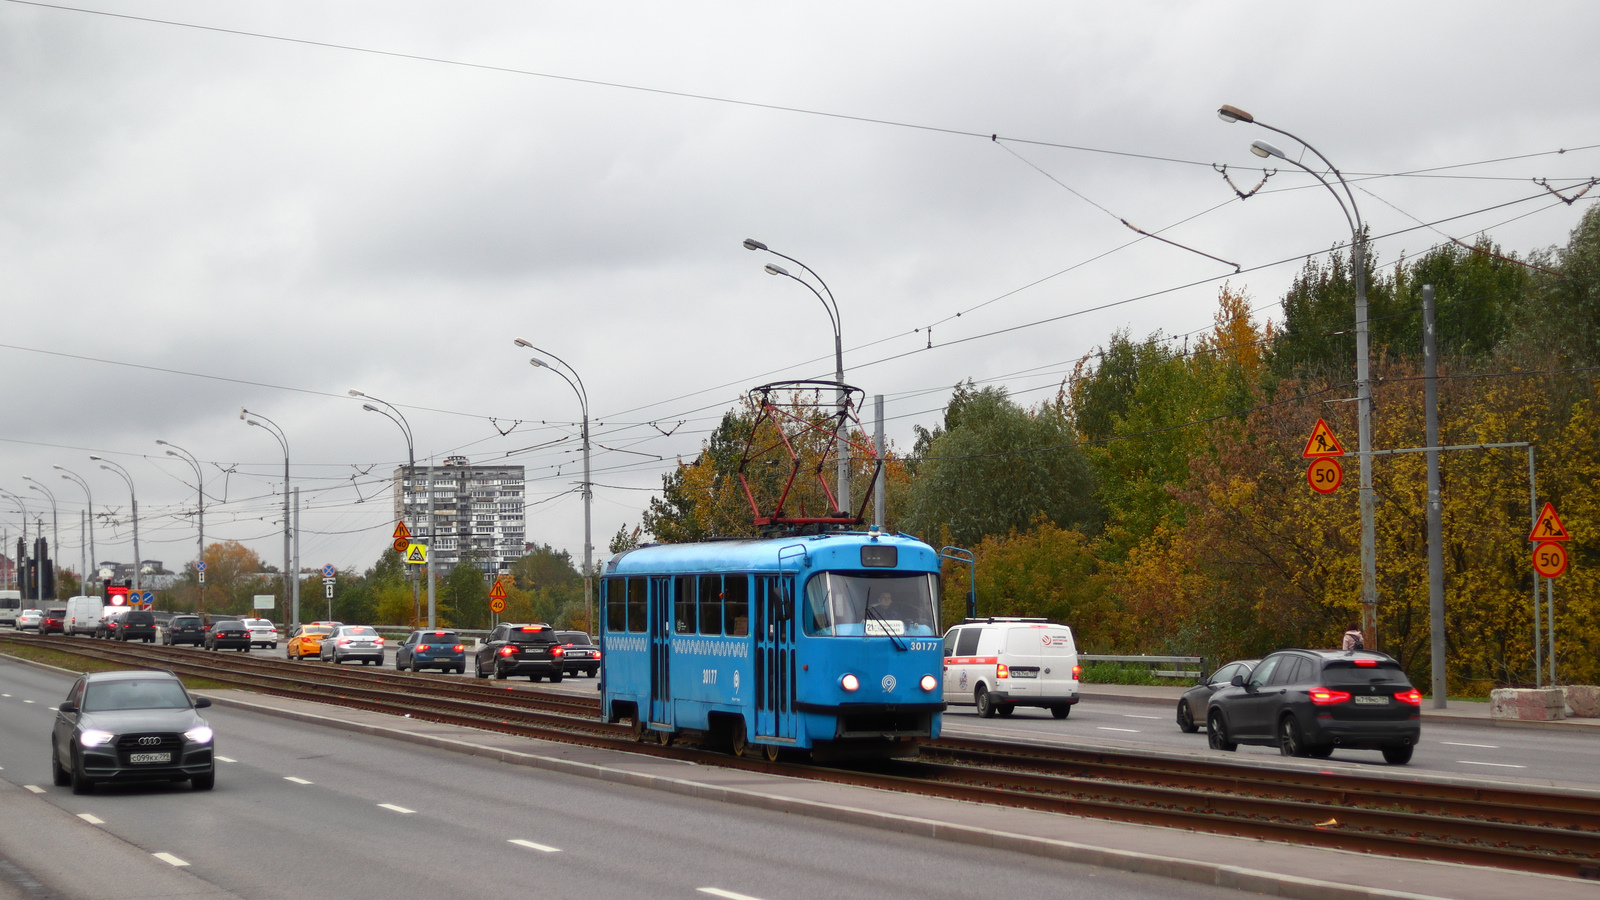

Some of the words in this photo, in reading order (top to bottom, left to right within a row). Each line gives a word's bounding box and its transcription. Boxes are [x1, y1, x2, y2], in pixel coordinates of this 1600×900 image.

[1316, 468, 1336, 483] 50
[1540, 552, 1560, 568] 50
[493, 601, 503, 609] 40
[866, 623, 874, 632] 21
[910, 642, 938, 651] 30177
[702, 669, 718, 684] 30177
